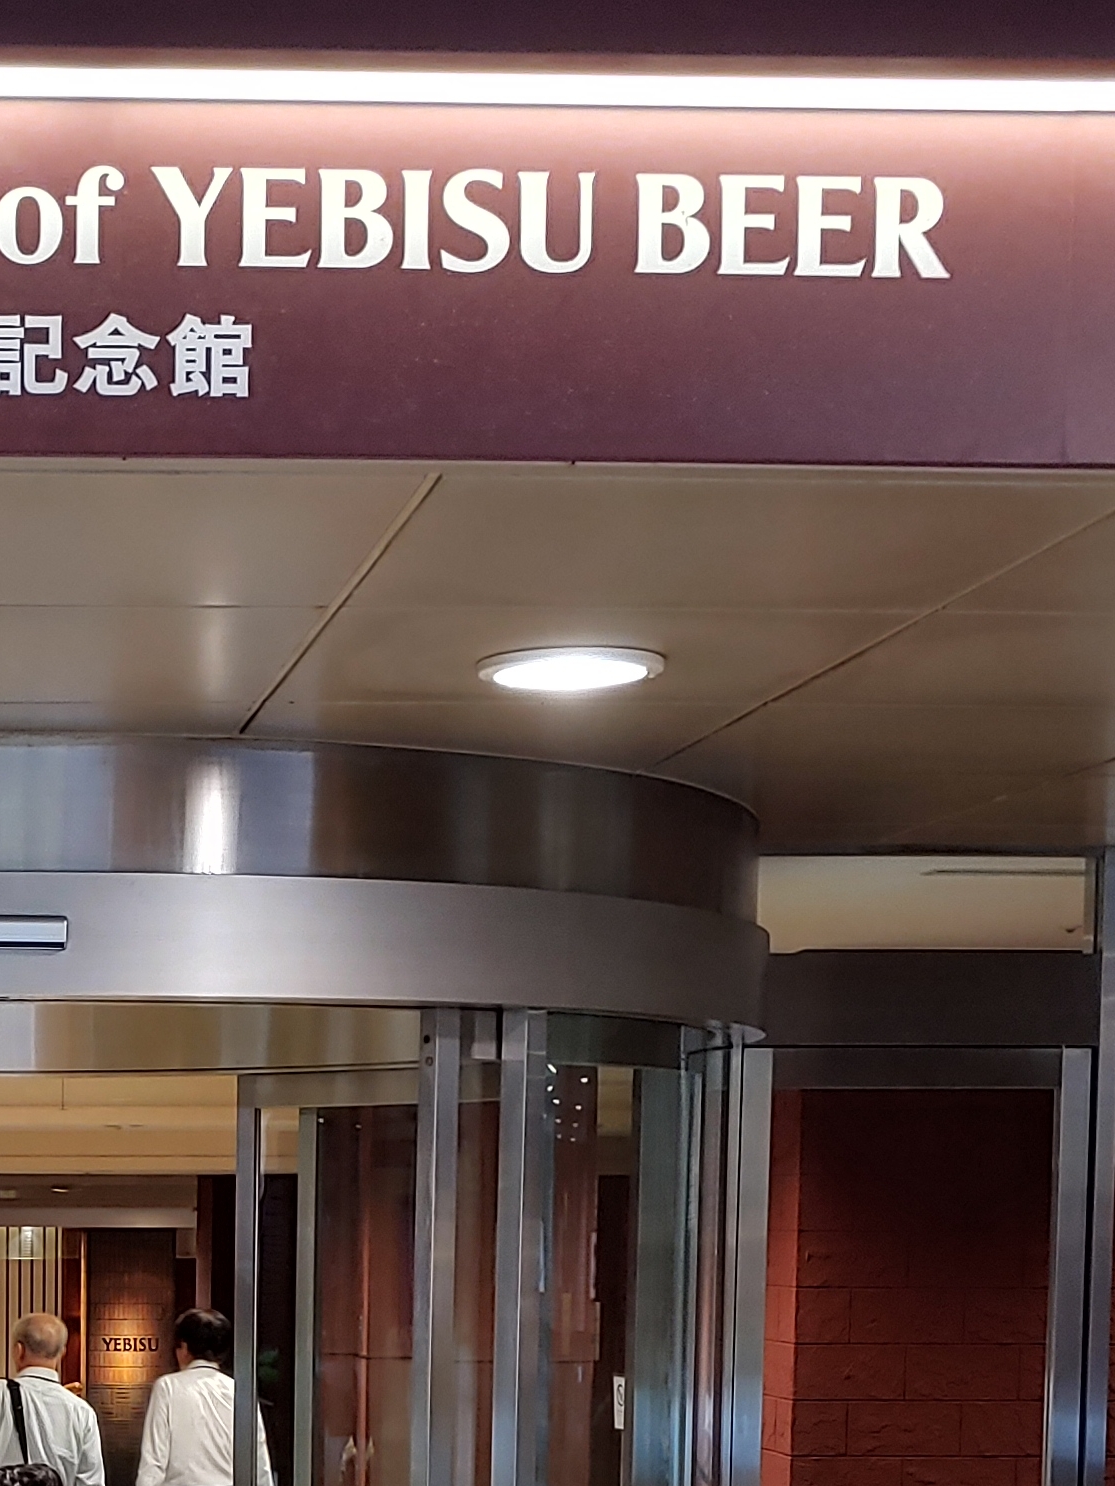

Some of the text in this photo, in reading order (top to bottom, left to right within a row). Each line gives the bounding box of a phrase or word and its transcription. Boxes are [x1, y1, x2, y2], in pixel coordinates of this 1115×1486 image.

[150, 166, 596, 275] YEBISU
[635, 171, 951, 279] BEER
[101, 1337, 160, 1352] YEBISU
